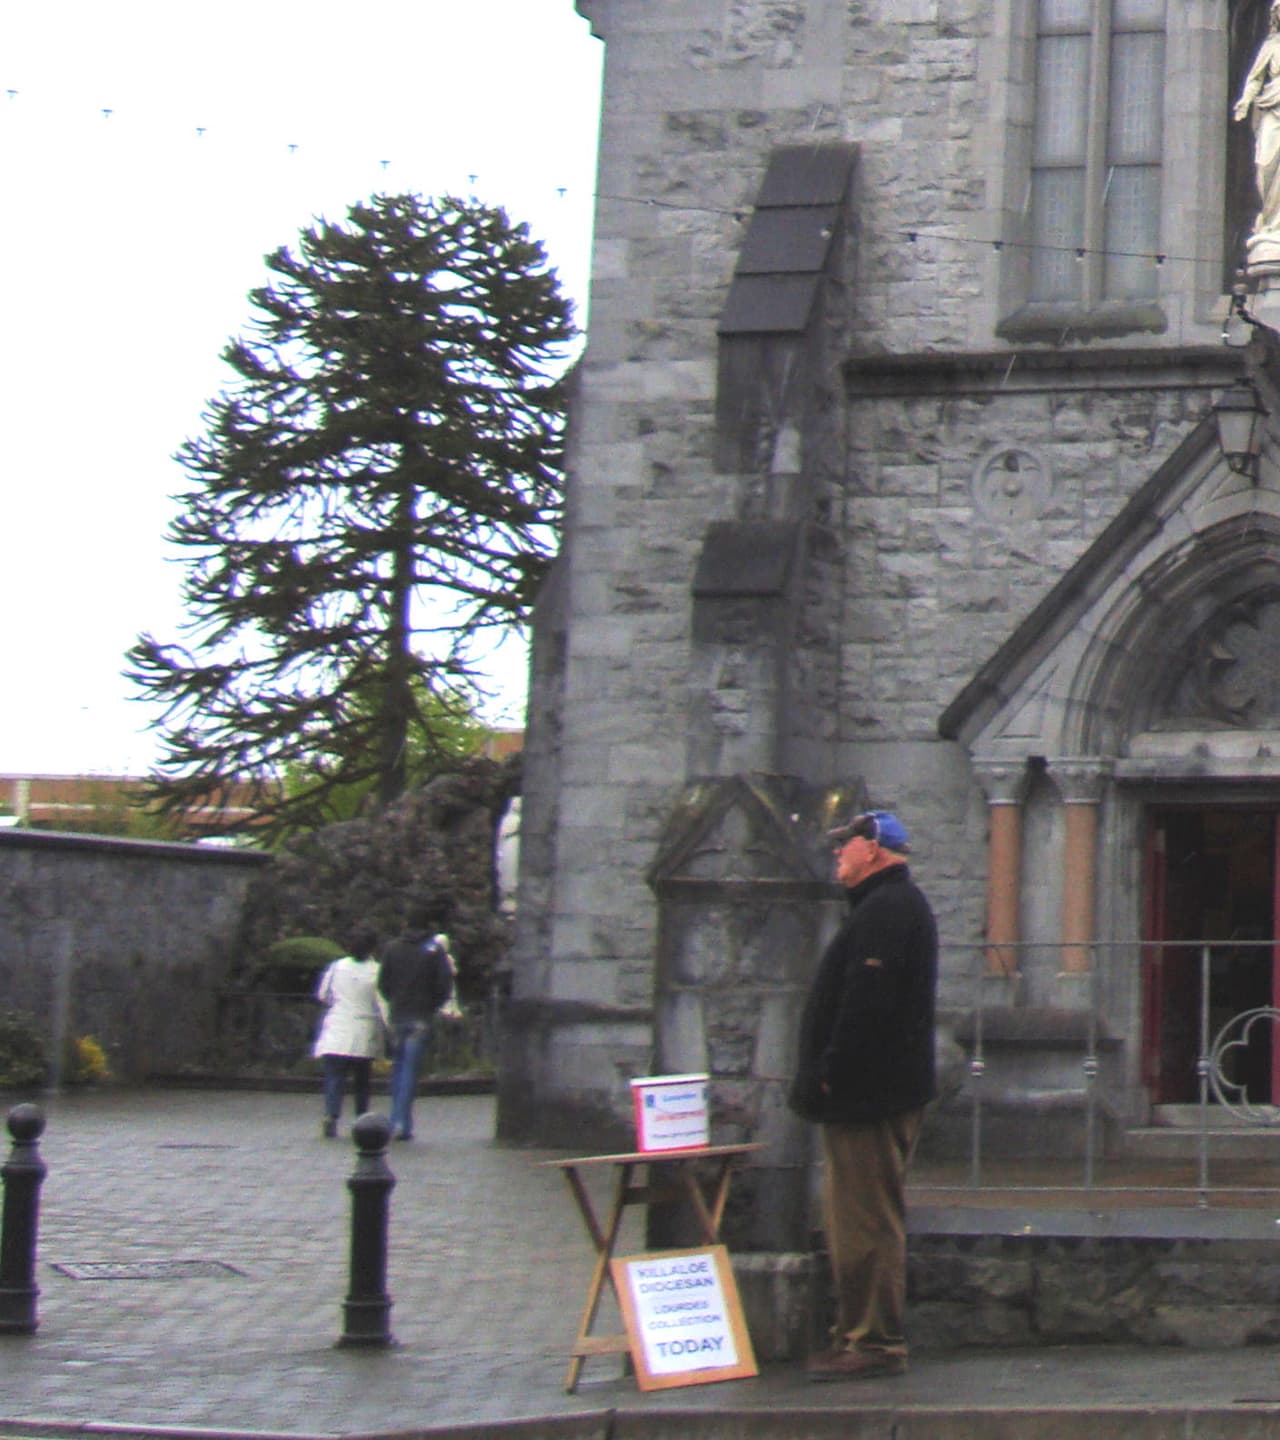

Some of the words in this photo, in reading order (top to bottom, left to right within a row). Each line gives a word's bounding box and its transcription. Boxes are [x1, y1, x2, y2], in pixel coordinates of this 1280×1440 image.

[637, 1262, 708, 1277] KILLALOE
[640, 1277, 714, 1294] DIOCESAN
[654, 1301, 708, 1315] LOURDES
[648, 1314, 721, 1331] COLLECTION
[655, 1336, 724, 1357] TODAY
